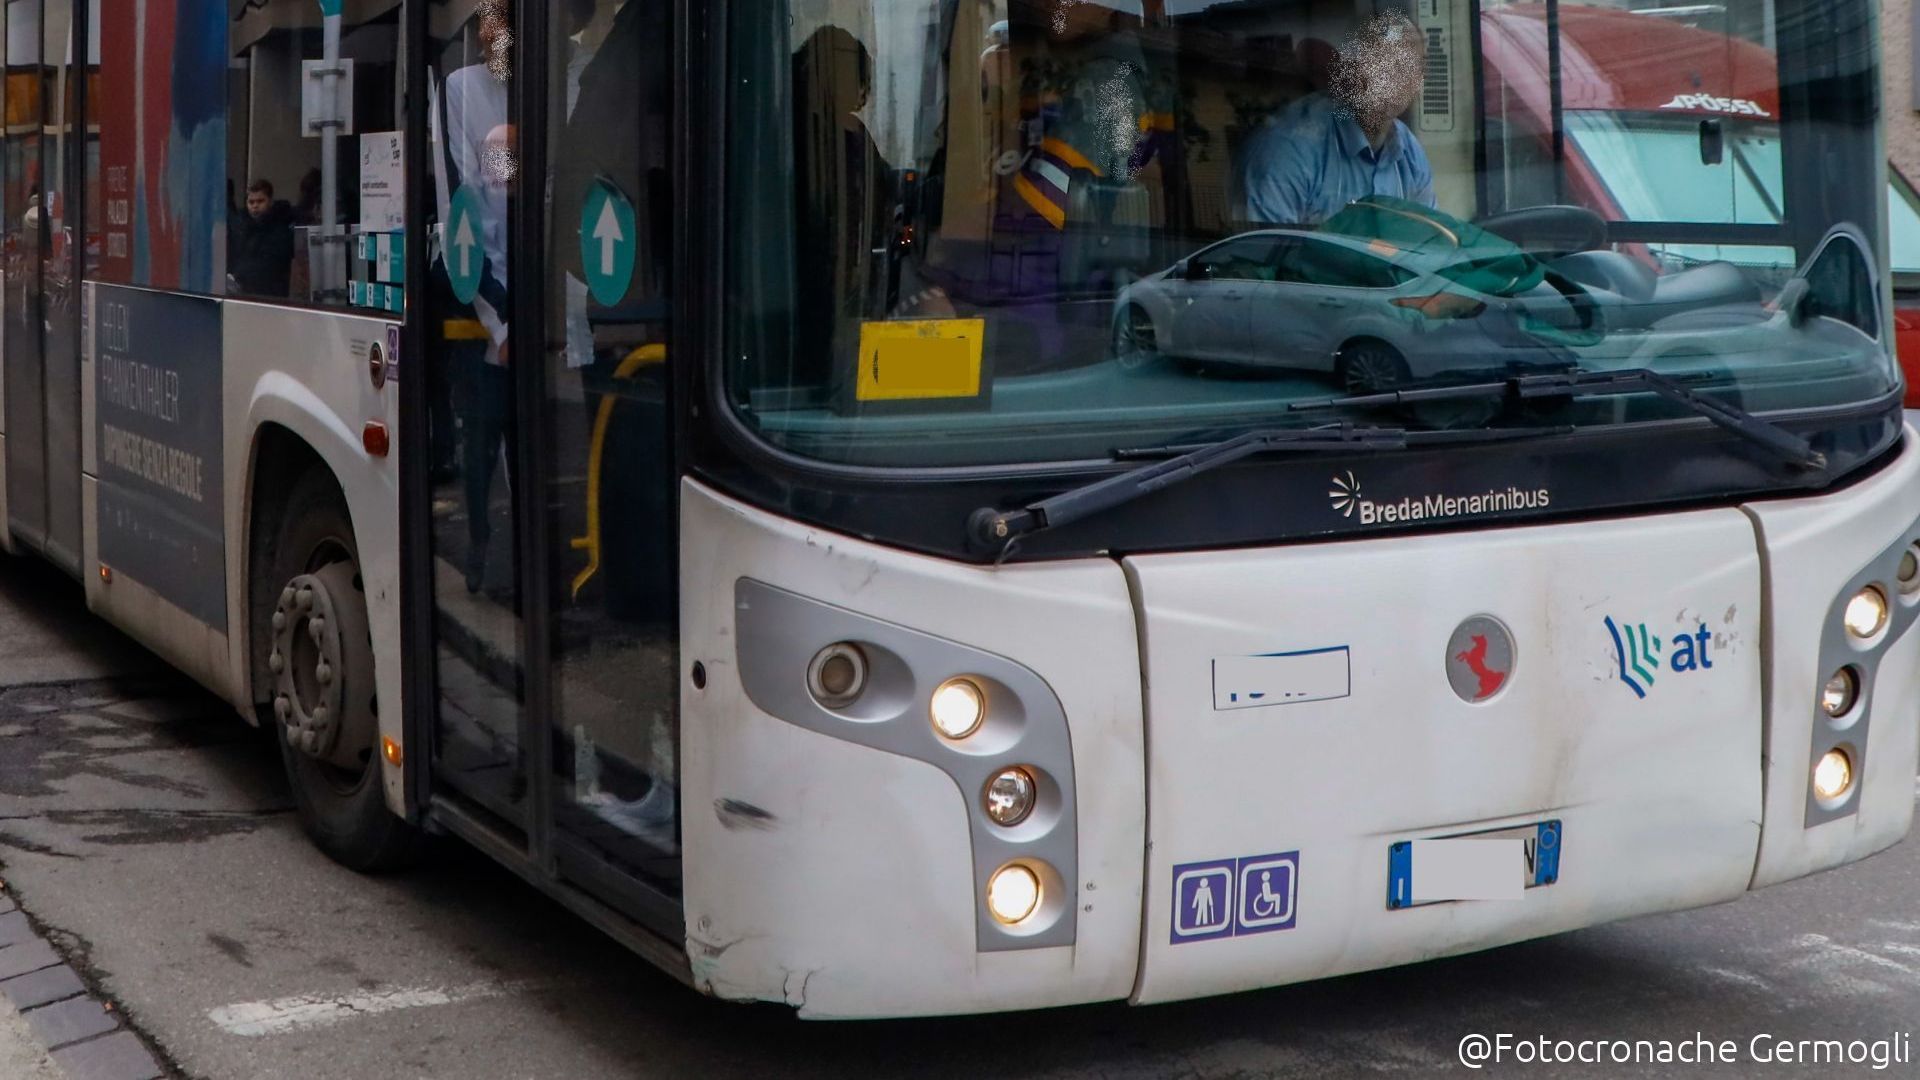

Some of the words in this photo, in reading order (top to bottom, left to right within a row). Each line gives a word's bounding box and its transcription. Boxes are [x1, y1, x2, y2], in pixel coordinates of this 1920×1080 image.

[1663, 93, 1770, 117] PÖSSL
[1359, 487, 1550, 525] BredaMenarinibus
[1670, 622, 1713, 673] at
